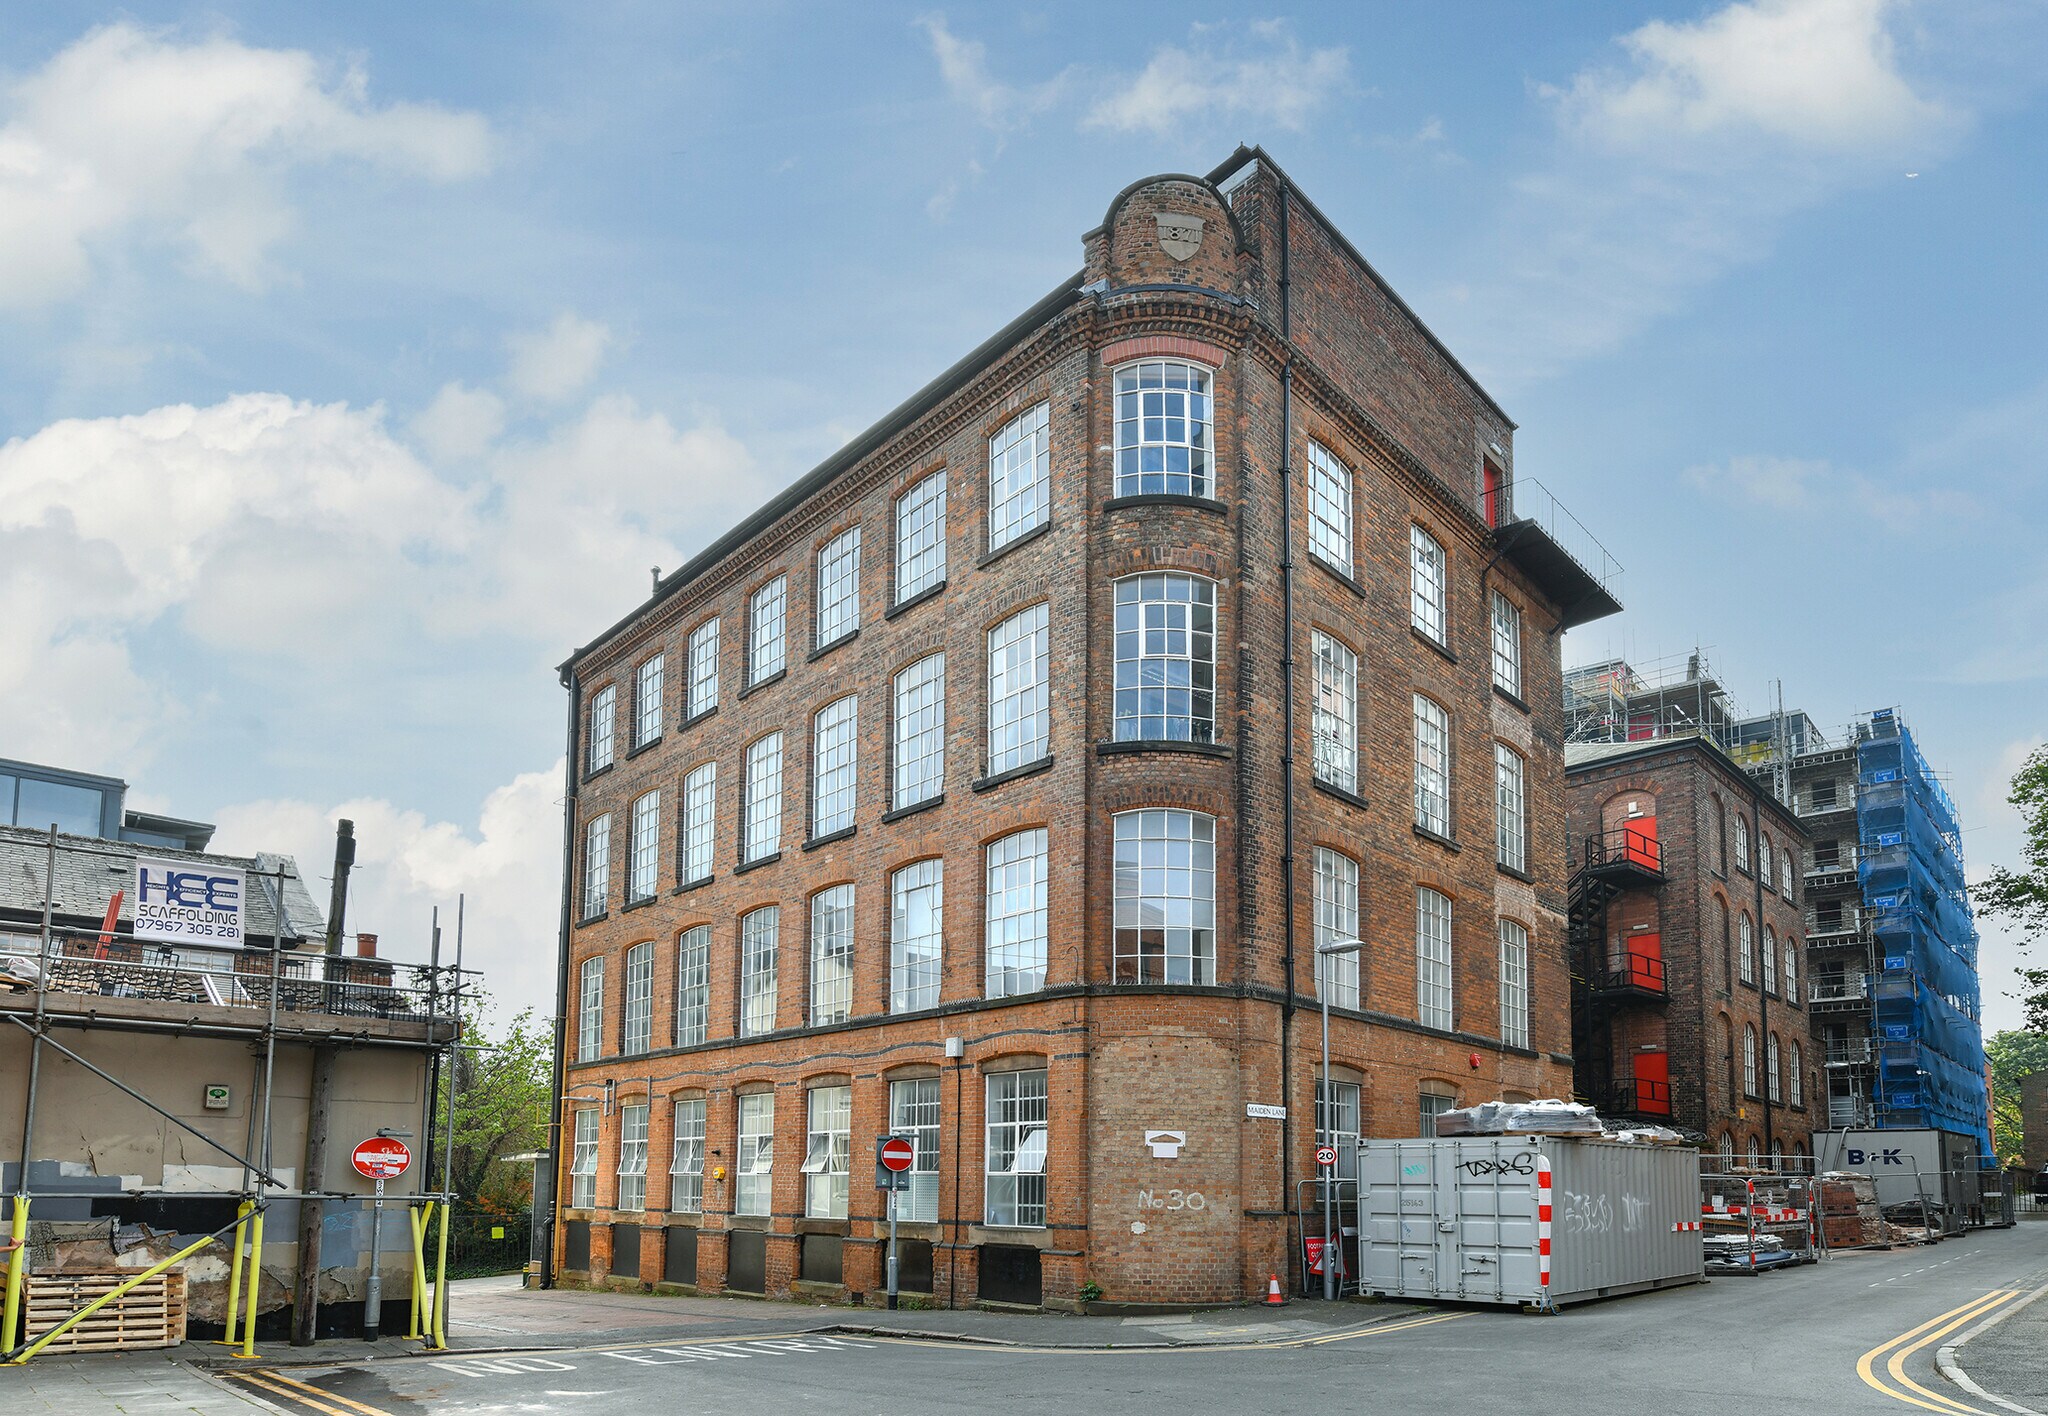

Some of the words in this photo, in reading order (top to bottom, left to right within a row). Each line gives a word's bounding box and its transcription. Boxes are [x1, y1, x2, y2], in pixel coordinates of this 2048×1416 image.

[139, 868, 238, 912] HEE
[145, 882, 170, 891] HEIGHTS
[179, 887, 206, 896] EFFICIENCY
[212, 891, 238, 899] EXPERTS
[139, 904, 238, 926] SCAFFOLDING
[135, 917, 183, 932] 07967
[187, 922, 213, 936] 305
[217, 926, 239, 938] 281
[1248, 1106, 1271, 1115] MAIDEN
[1272, 1109, 1285, 1117] LANE
[1318, 1152, 1334, 1160] 20
[1166, 1188, 1205, 1211] 30
[427, 1357, 577, 1377] NO
[600, 1337, 877, 1366] ENTRY
